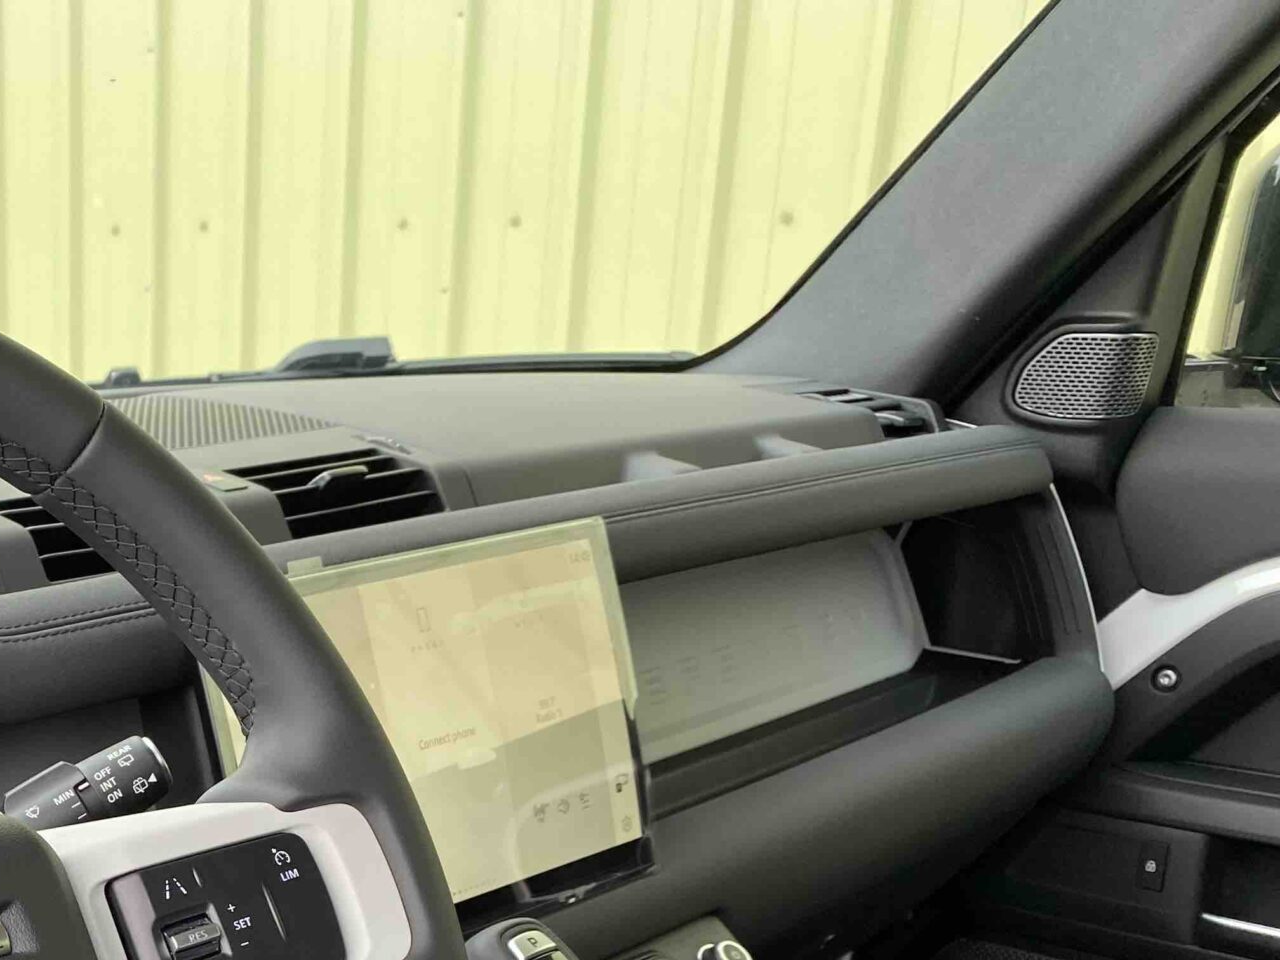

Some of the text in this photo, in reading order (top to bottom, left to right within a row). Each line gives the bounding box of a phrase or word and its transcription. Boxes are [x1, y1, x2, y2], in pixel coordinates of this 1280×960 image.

[418, 727, 477, 750] Connect phone
[106, 744, 133, 761] REAR
[93, 765, 112, 781] OFF
[100, 777, 117, 793] INT
[52, 789, 76, 806] MIN
[107, 788, 123, 804] ON
[279, 868, 300, 882] LIM
[233, 916, 252, 931] SET
[188, 930, 209, 944] RES
